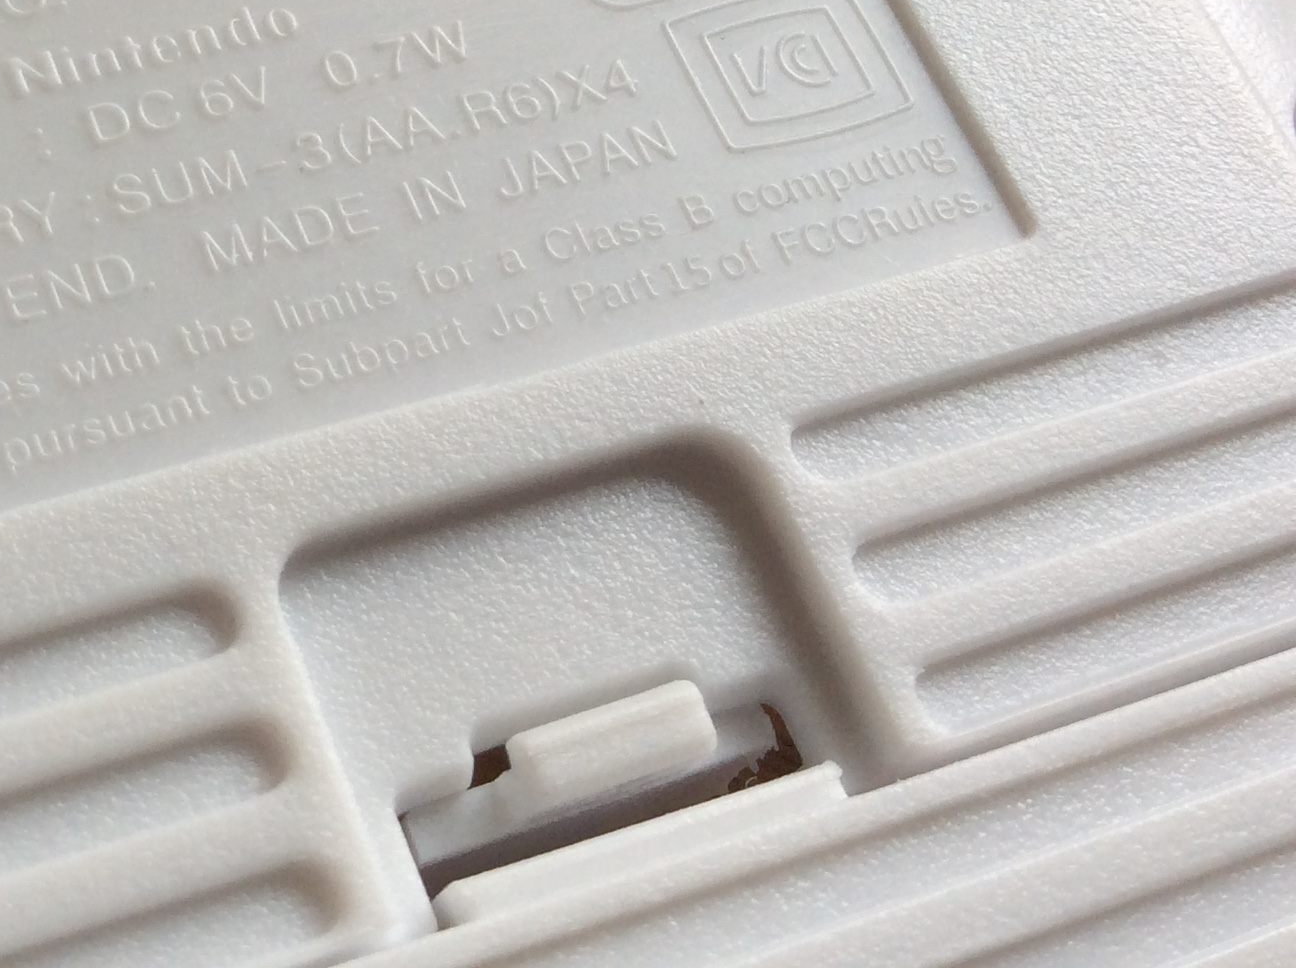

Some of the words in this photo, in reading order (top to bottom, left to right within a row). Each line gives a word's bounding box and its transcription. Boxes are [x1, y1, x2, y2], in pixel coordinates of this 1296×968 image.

[8, 6, 300, 94] Nintendo
[323, 19, 469, 89] 0.7W
[60, 335, 160, 389] with
[180, 315, 256, 357] the
[272, 278, 398, 331] limits
[413, 255, 477, 295] for
[501, 245, 528, 275] a
[543, 211, 666, 261] Class
[677, 193, 715, 230] B
[733, 133, 958, 216] computing
[203, 191, 380, 272] MADE
[402, 169, 467, 221] IN
[498, 118, 679, 200] JAPAN
[3, 382, 211, 478] pursuant
[226, 371, 274, 409] to
[292, 314, 471, 390] Subpart
[568, 267, 660, 321] Part
[659, 253, 713, 293] 15
[718, 237, 762, 277] of
